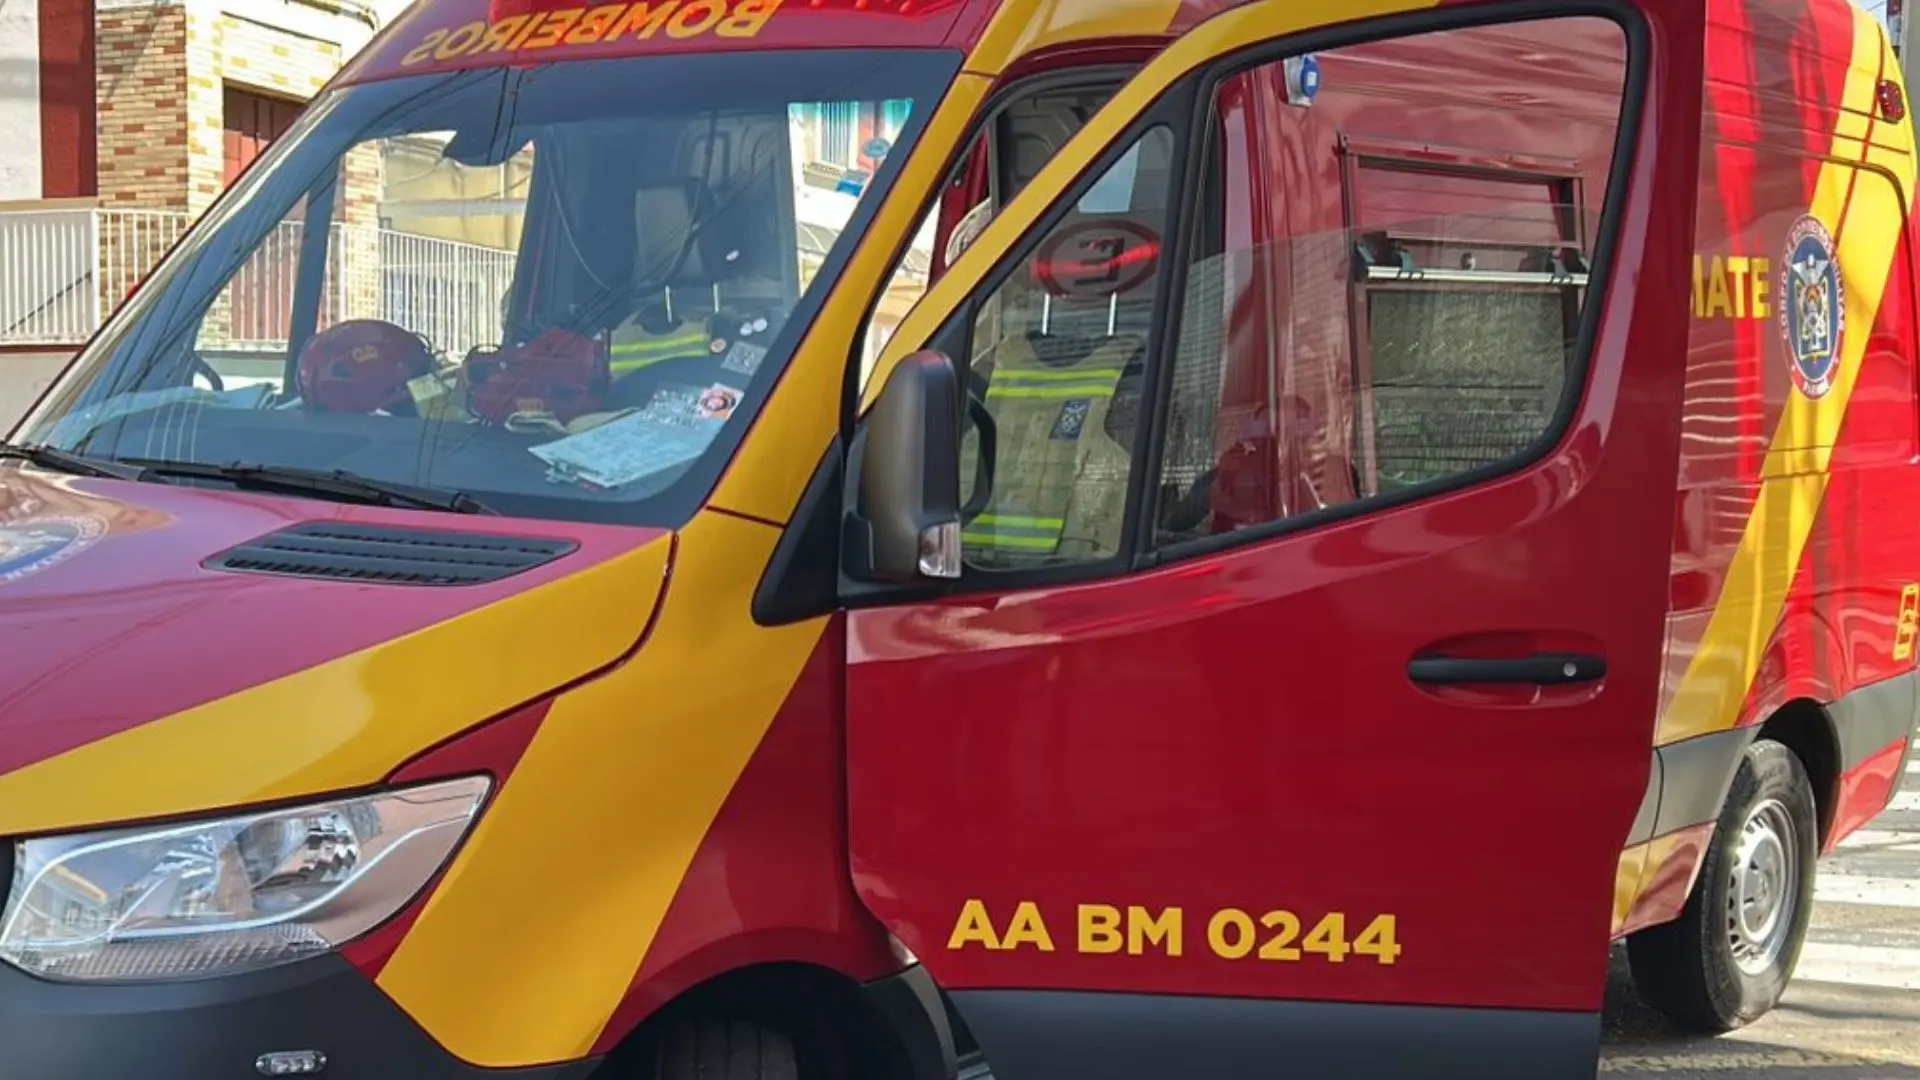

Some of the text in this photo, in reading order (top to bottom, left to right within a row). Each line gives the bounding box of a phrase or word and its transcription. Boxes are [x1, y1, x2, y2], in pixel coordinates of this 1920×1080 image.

[947, 899, 1401, 964] AA BM 0244
